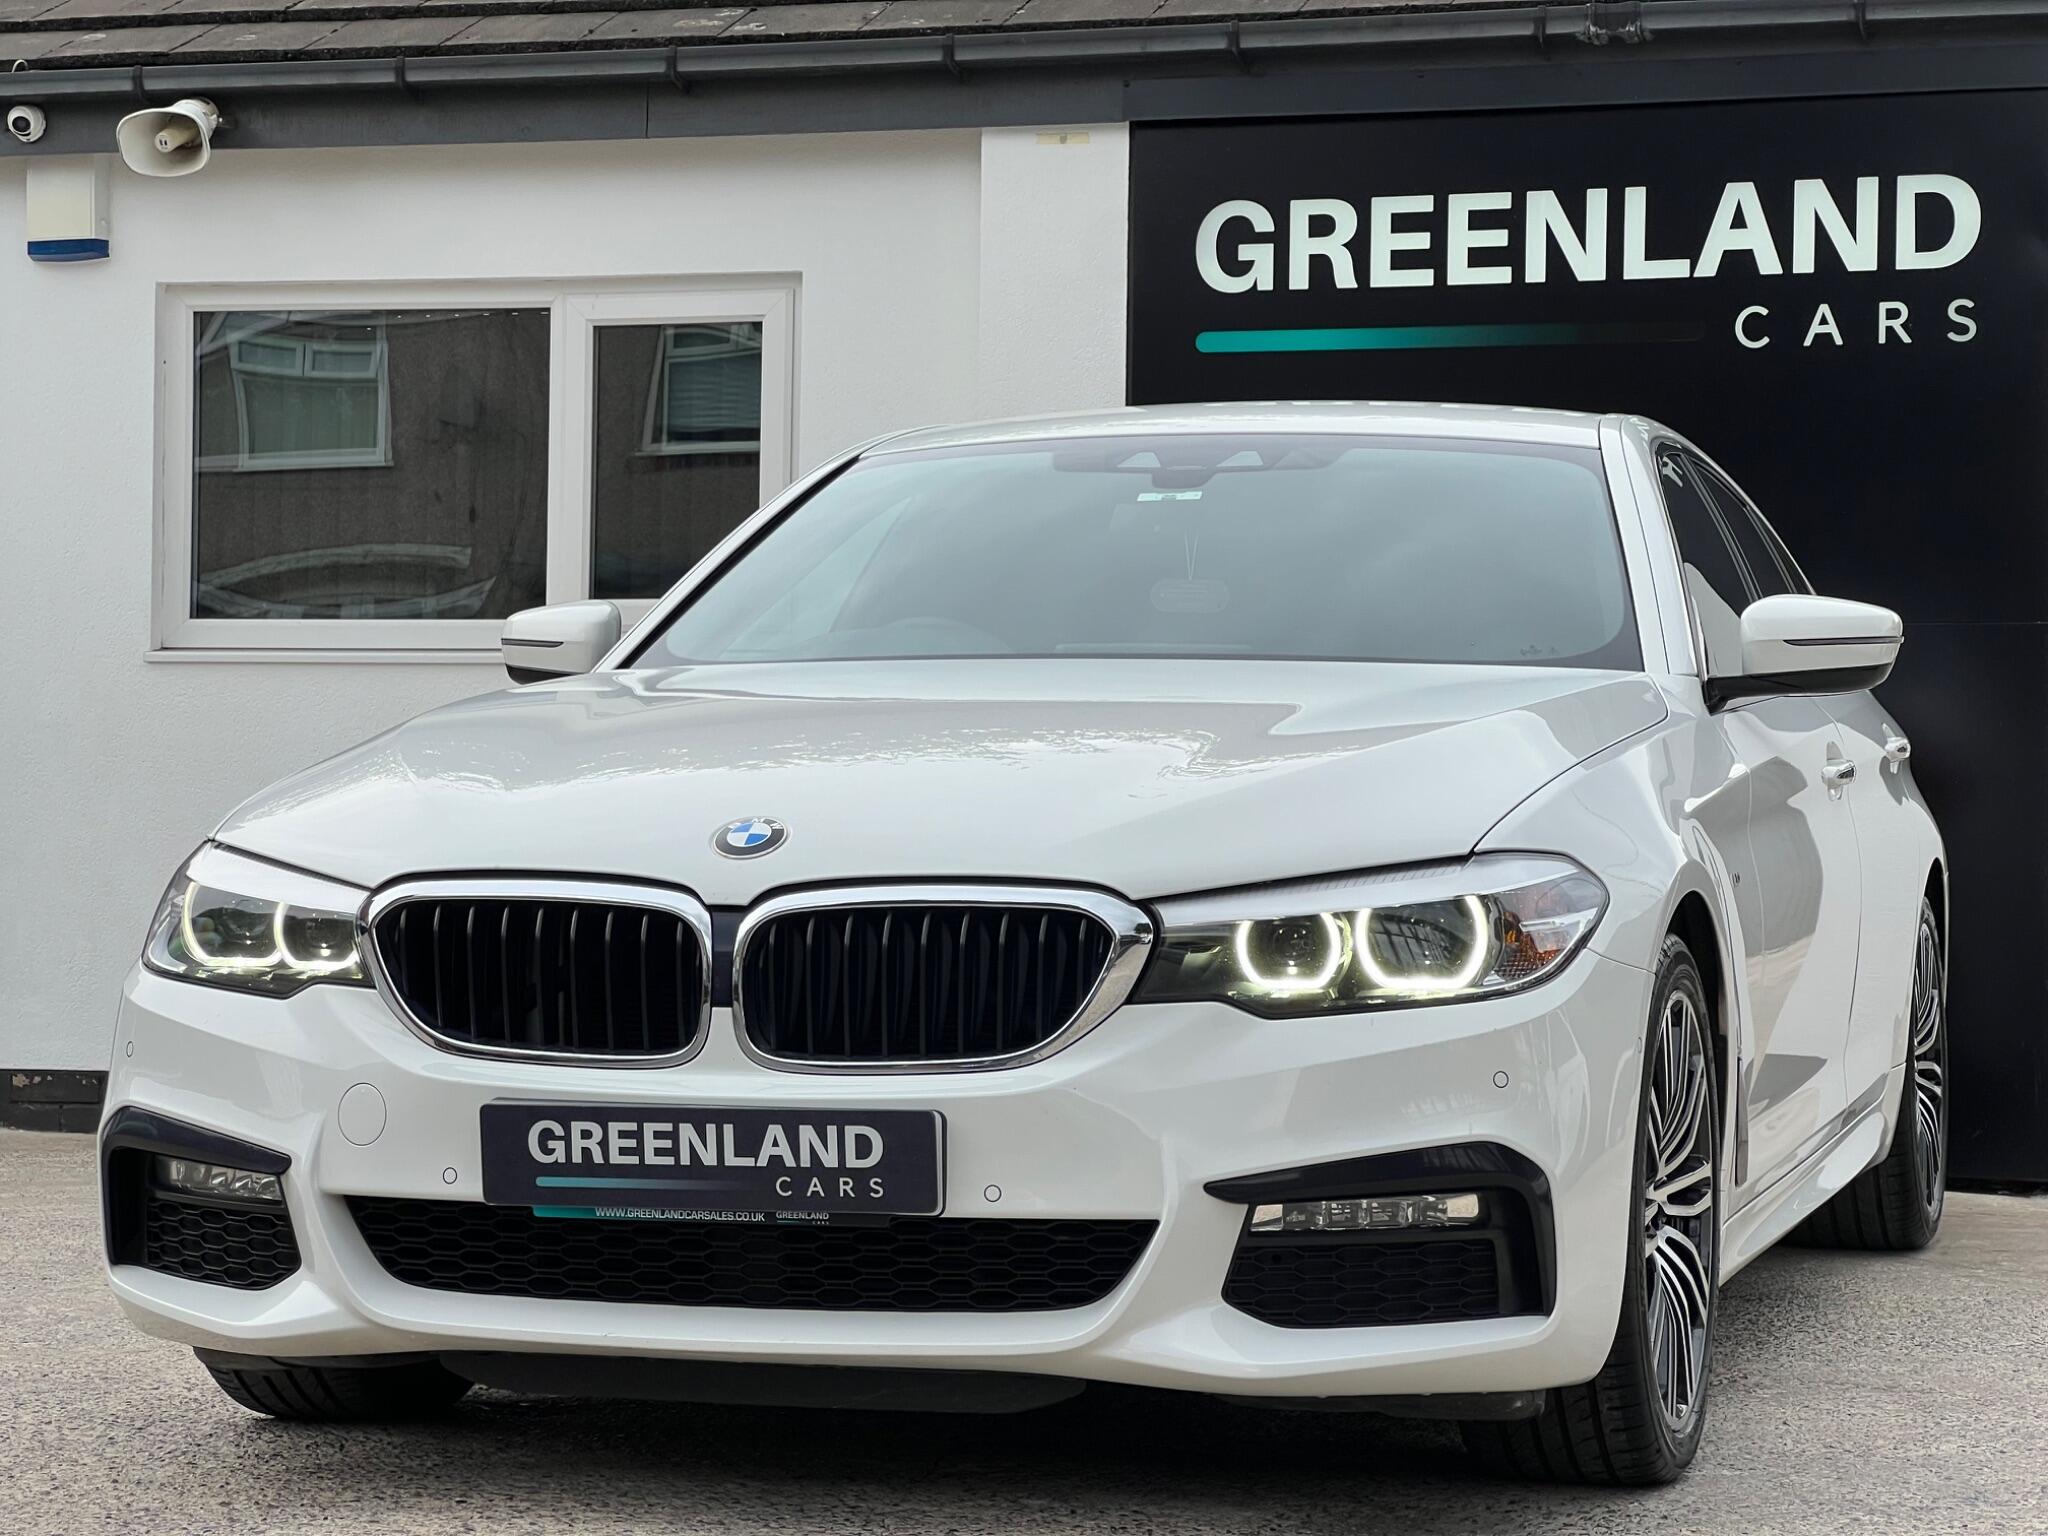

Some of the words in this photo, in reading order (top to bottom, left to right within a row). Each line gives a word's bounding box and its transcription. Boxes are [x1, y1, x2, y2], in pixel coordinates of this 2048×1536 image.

[1195, 173, 1983, 294] GREENLAND
[1734, 298, 1978, 349] CARS
[527, 1119, 884, 1169] GREENLAND
[775, 1176, 884, 1198] CARS
[595, 1207, 765, 1222] WWW.GREENLANDCARSALES.CO.UK
[775, 1210, 830, 1220] GREENLAND
